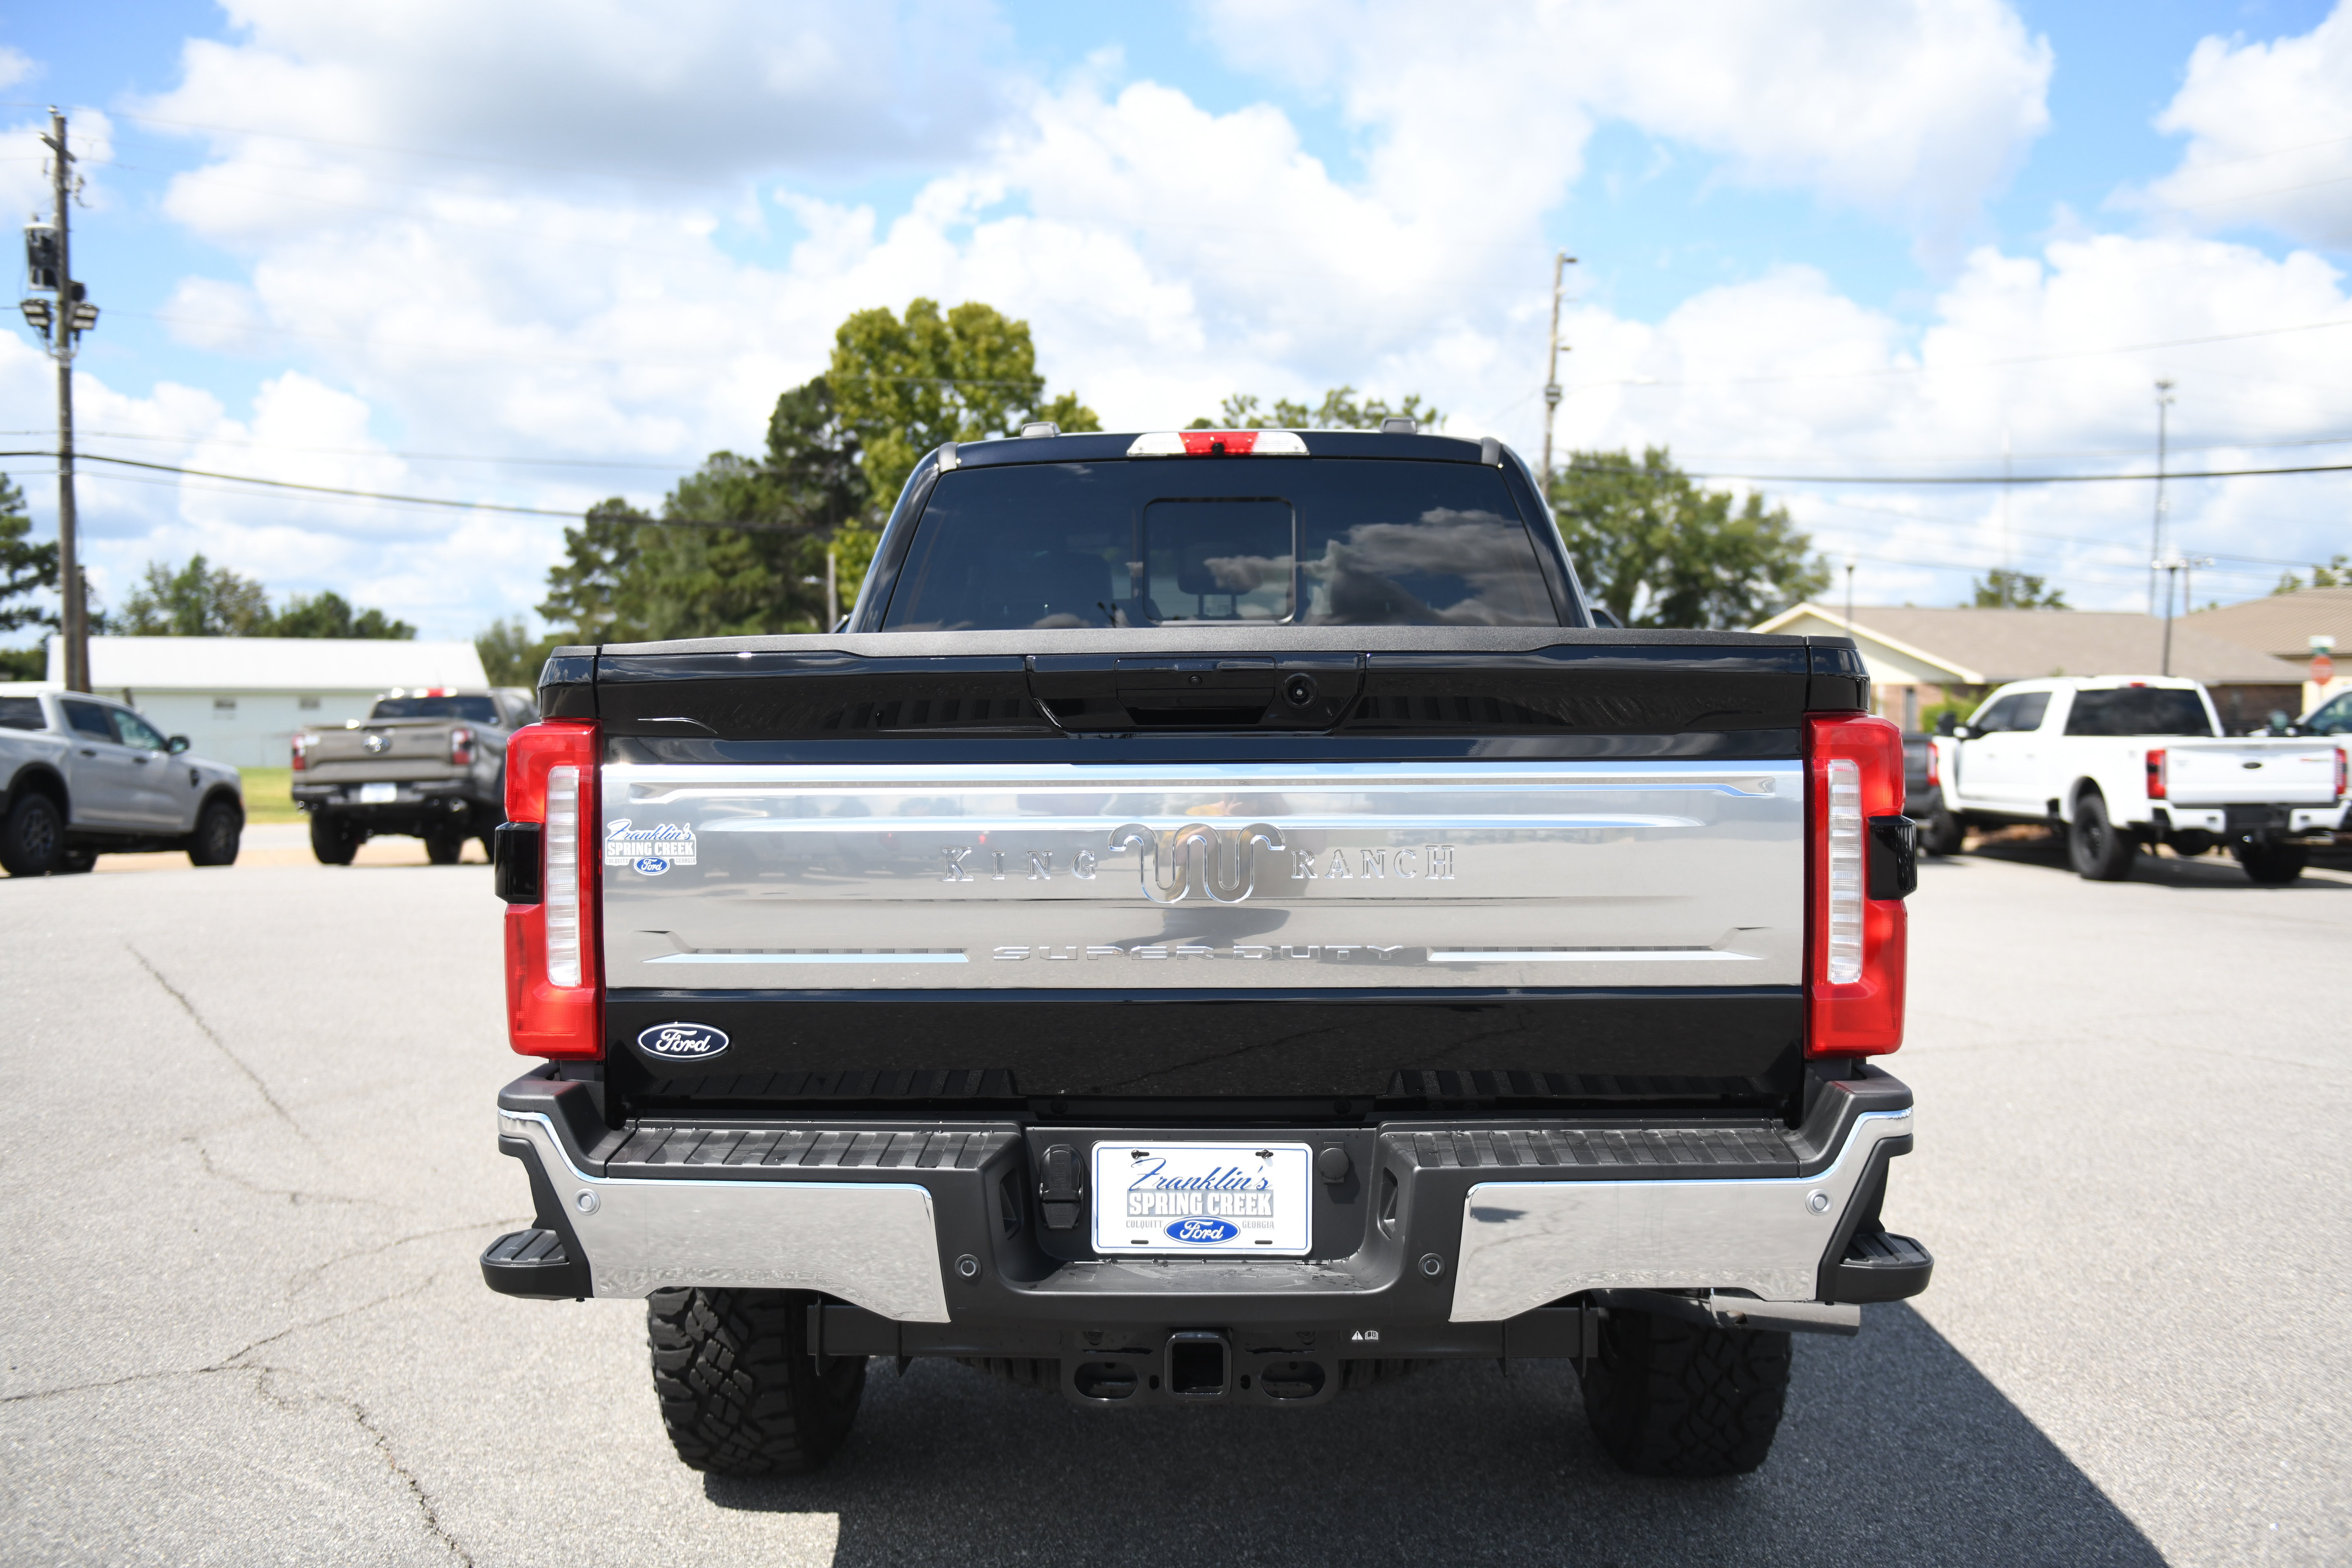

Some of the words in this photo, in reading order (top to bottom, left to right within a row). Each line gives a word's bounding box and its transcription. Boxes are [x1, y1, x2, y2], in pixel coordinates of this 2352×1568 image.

[608, 821, 694, 842] Franklin's
[608, 842, 653, 856] SPRING
[654, 842, 694, 856] CREEK
[641, 858, 663, 871] Ford
[942, 846, 1096, 882] KING
[1291, 845, 1455, 880] RANCH
[993, 945, 1214, 960] SUPER
[1233, 945, 1404, 960] DUTY
[656, 1029, 712, 1052] Ford
[1128, 1157, 1273, 1192] Franklin's
[1129, 1192, 1203, 1216] SPRING
[1207, 1192, 1273, 1216] CREEK
[1125, 1219, 1163, 1229] COLQUITT
[1242, 1220, 1275, 1229] GEORGIA
[1180, 1221, 1223, 1240] Ford
